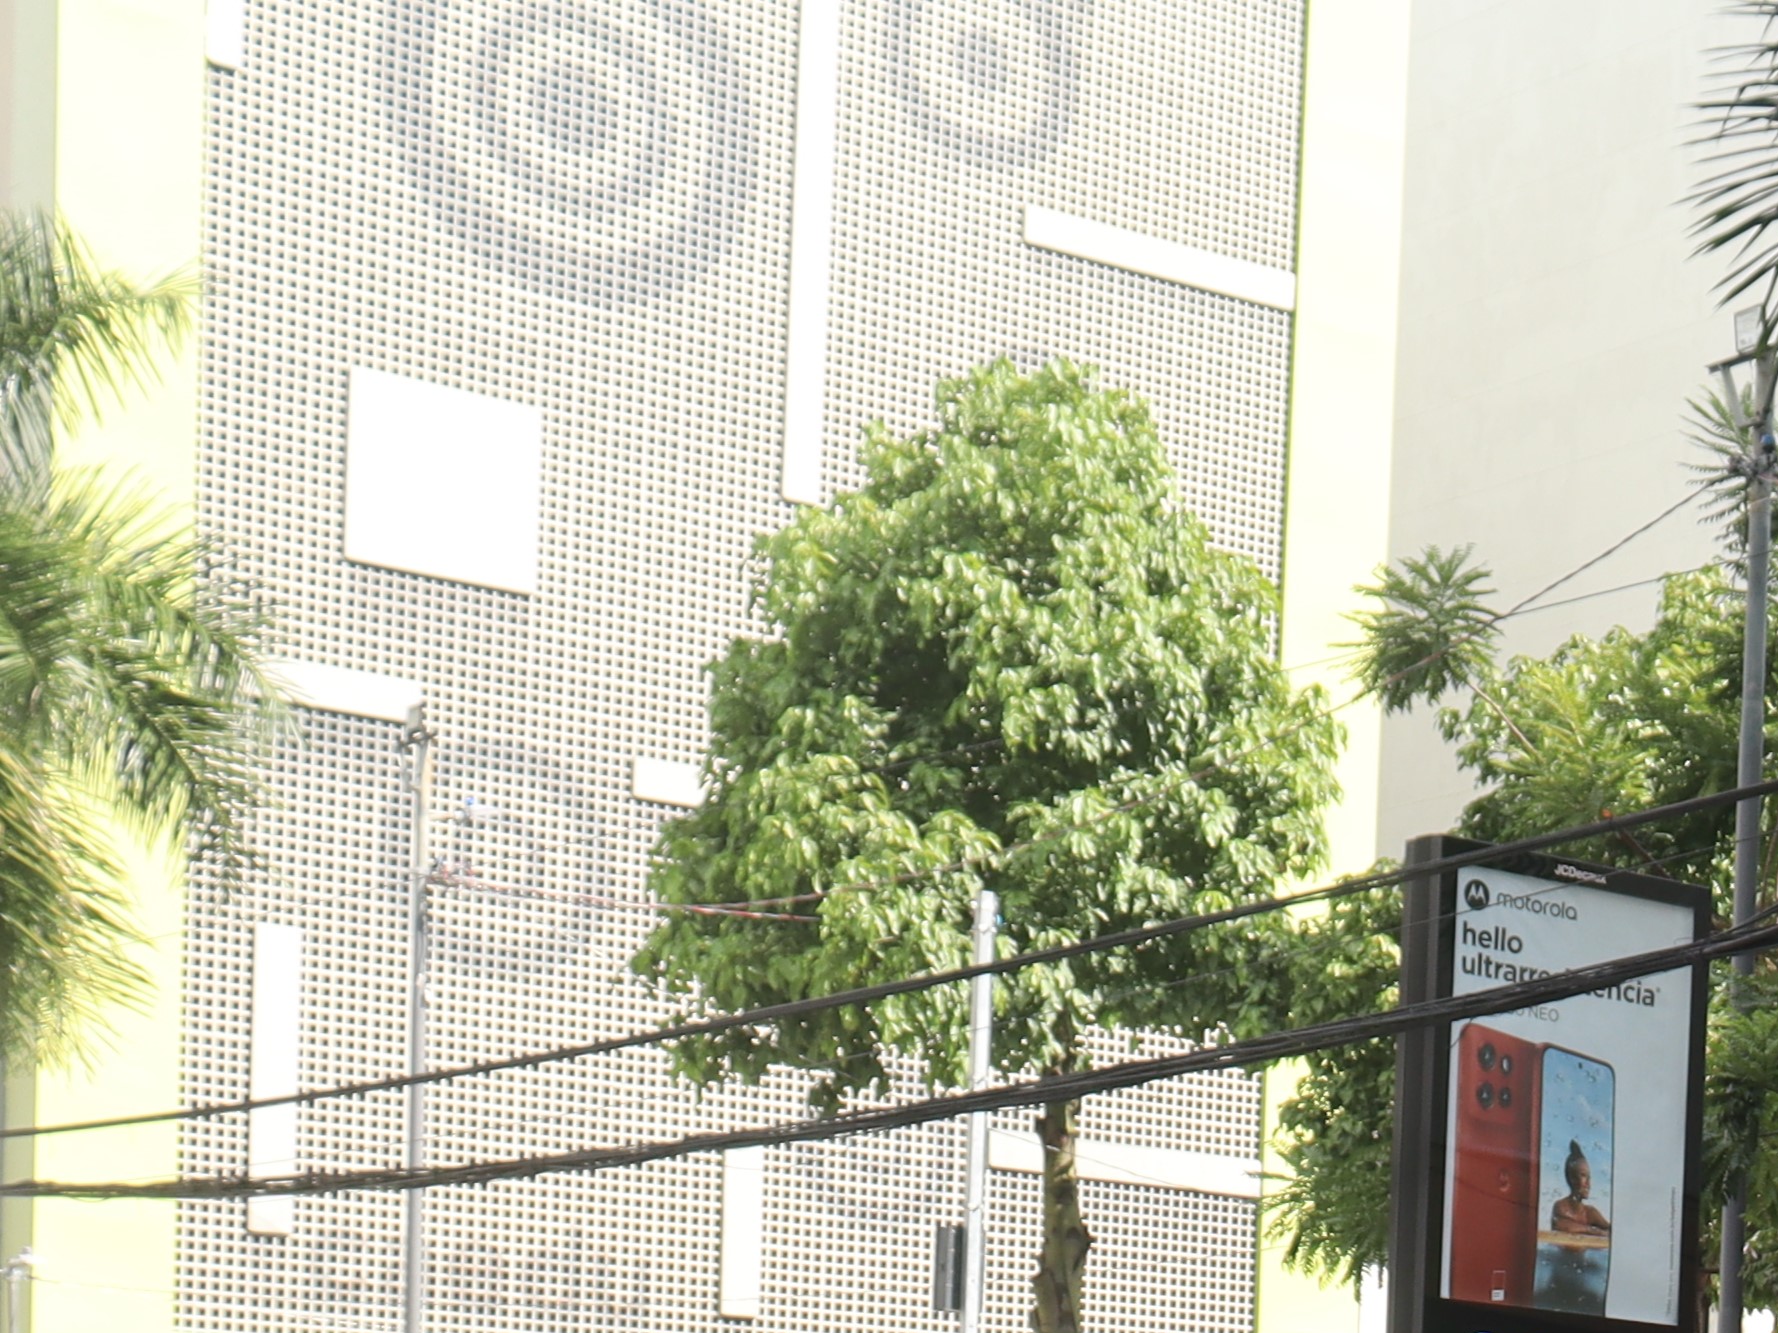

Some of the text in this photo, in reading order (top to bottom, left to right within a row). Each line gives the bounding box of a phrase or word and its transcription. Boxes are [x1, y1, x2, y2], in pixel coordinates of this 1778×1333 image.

[1496, 892, 1578, 921] motorola
[1462, 920, 1523, 954] hello
[1527, 1004, 1560, 1022] NEO
